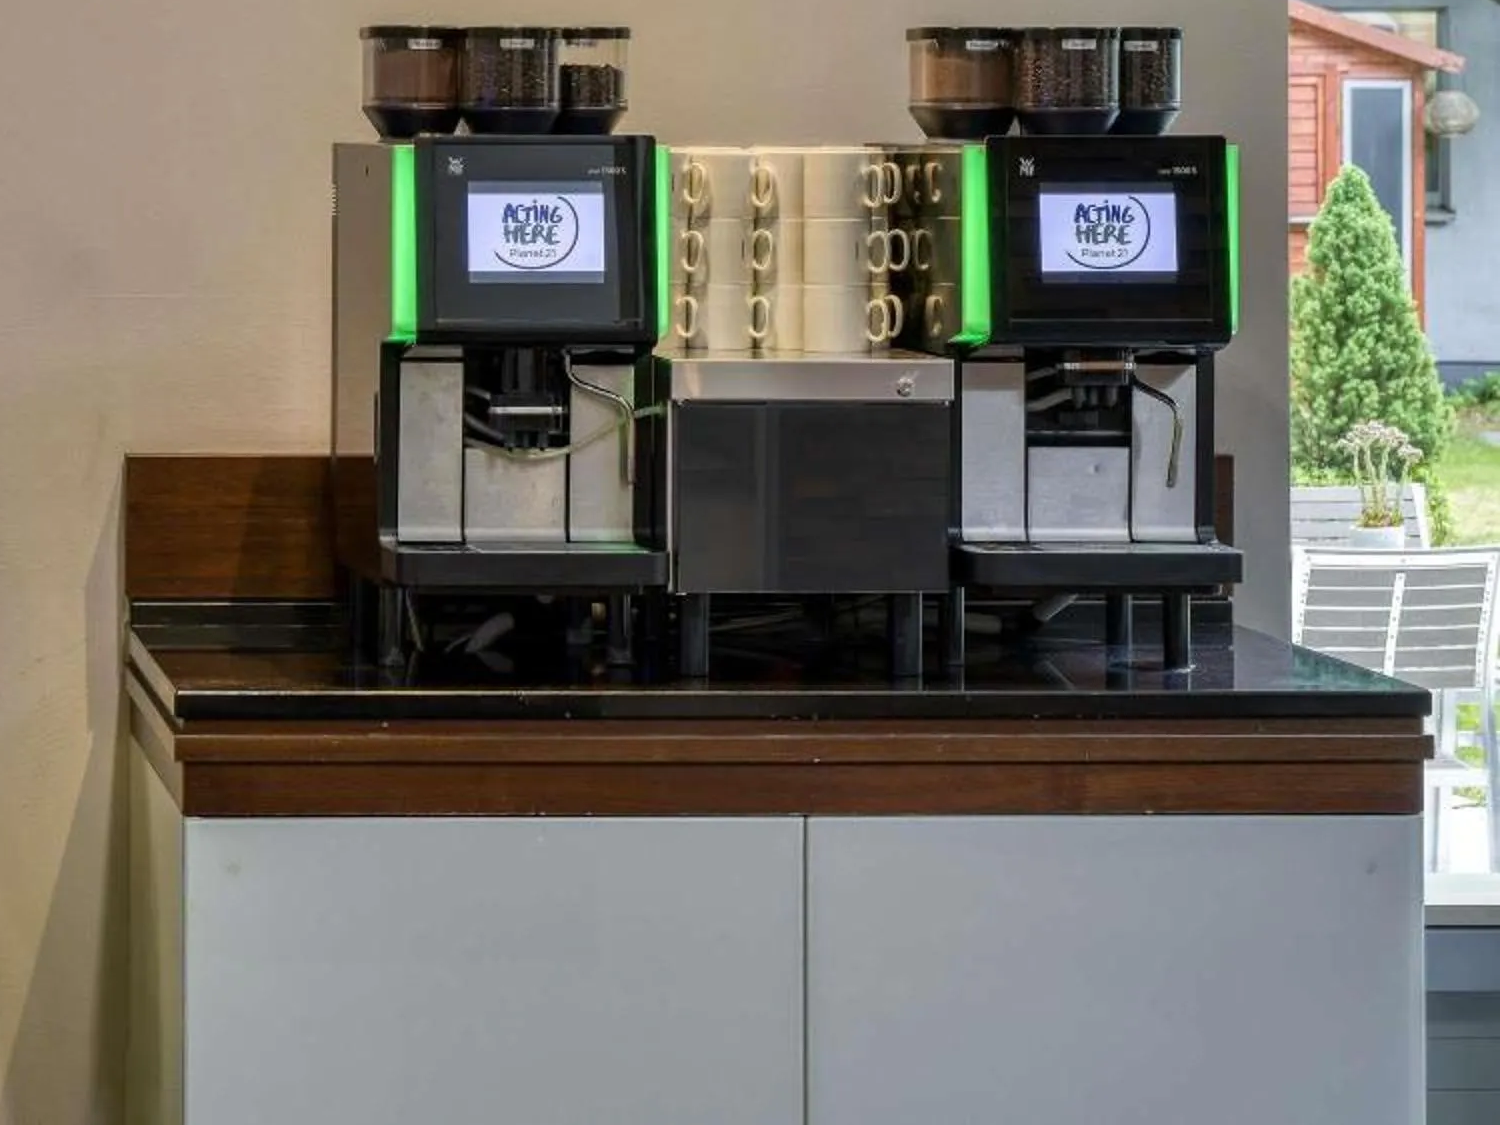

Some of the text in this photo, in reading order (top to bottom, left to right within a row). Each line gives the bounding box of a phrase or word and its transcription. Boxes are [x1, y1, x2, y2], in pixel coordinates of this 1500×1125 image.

[502, 199, 563, 225] ACTING
[1073, 199, 1135, 225] ACTING
[504, 224, 560, 245] HERE
[1076, 224, 1132, 245] HERE
[1081, 248, 1115, 258] Planet
